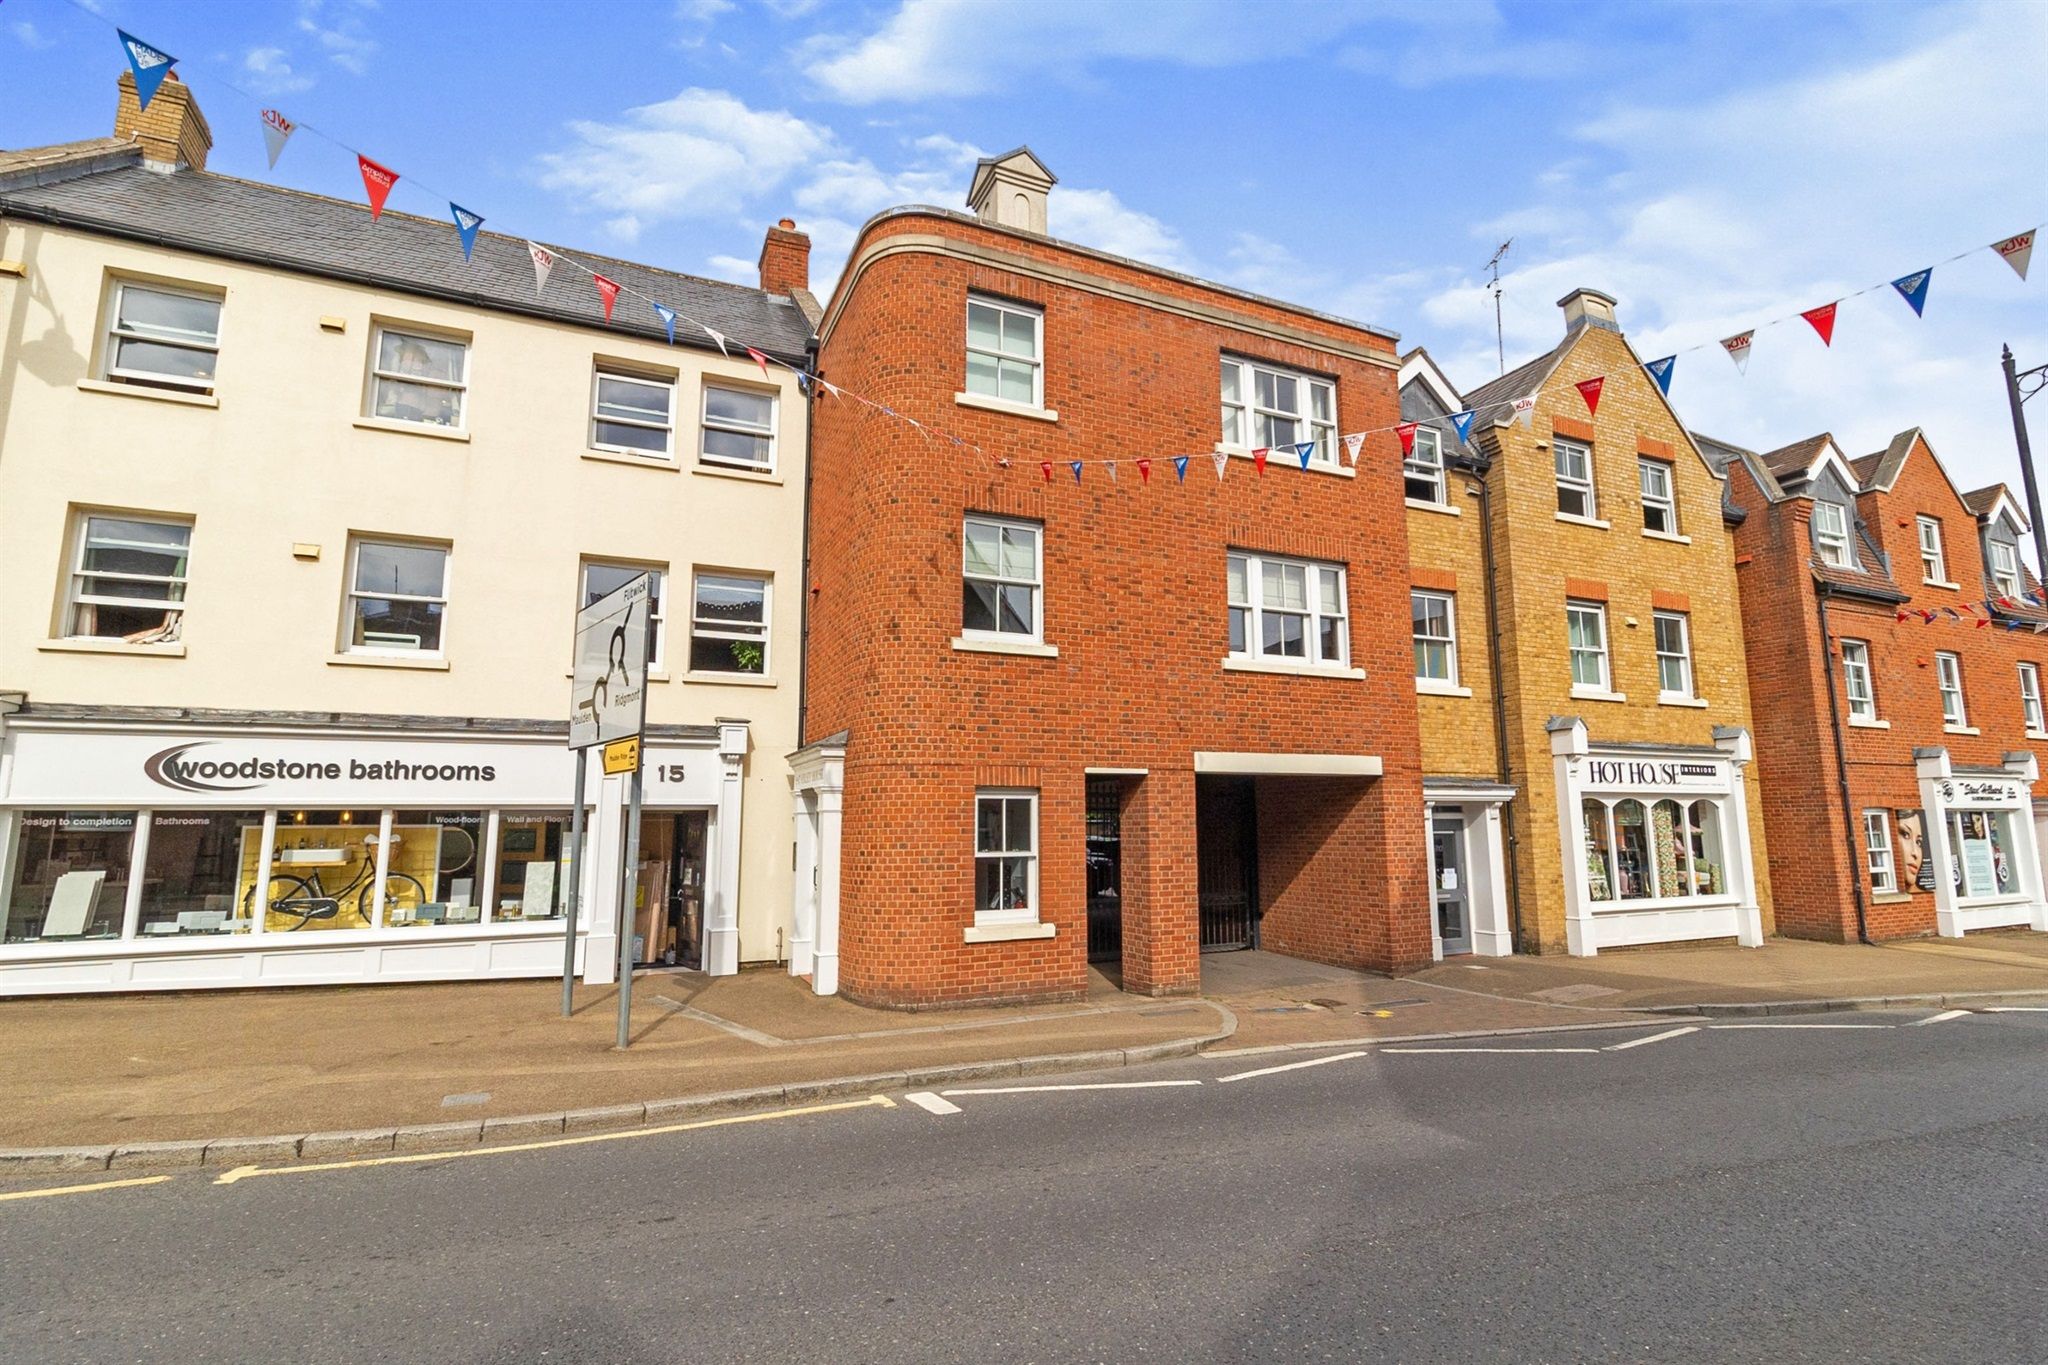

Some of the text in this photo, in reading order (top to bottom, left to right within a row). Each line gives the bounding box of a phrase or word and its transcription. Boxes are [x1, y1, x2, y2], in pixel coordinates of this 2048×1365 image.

[261, 109, 291, 132] KJW
[2000, 236, 2030, 254] KJW
[534, 250, 552, 265] KJW
[1727, 335, 1749, 350] KJW
[615, 688, 640, 707] Ridgmont
[171, 757, 496, 782] woodstone bathrooms
[658, 764, 685, 783] 15
[1589, 761, 1716, 785] HOT HOUSE INTERIORS
[20, 816, 132, 828] Design to completion
[155, 816, 210, 826] Bathrooms
[507, 815, 525, 823] Wall
[527, 815, 542, 823] and
[544, 815, 565, 823] Floor
